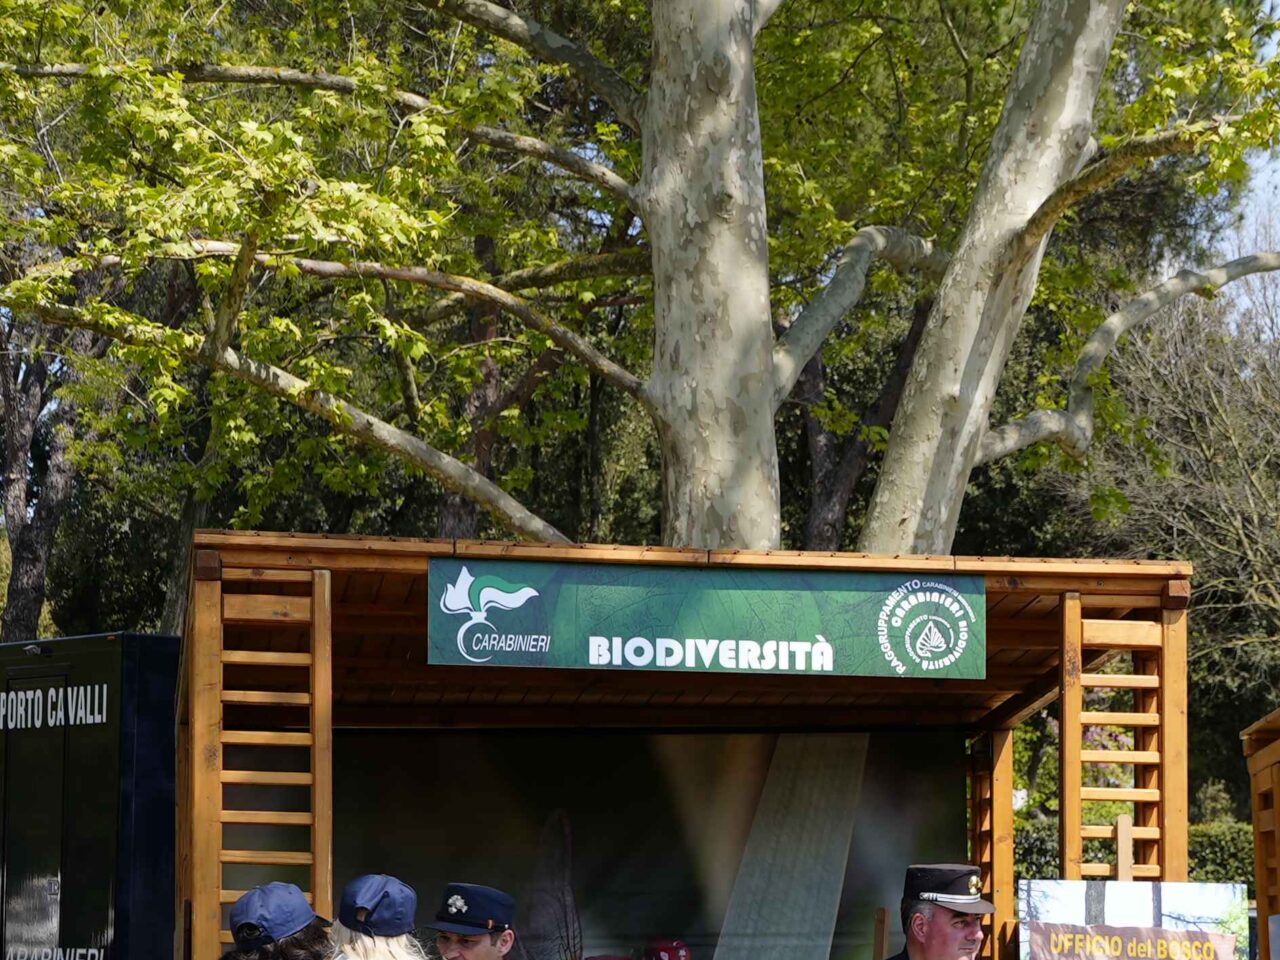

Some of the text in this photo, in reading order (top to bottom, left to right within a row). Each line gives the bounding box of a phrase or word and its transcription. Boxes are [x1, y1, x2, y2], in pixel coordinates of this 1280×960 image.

[878, 579, 921, 675] RAGGRUPPAMENTO
[891, 591, 964, 627] CARABINIERI
[472, 633, 551, 653] CARABINIERI
[588, 634, 834, 671] BIODIVERSITÀ
[0, 688, 43, 730] PORTO
[1051, 932, 1123, 957] UFFICIO
[1127, 937, 1151, 958] del
